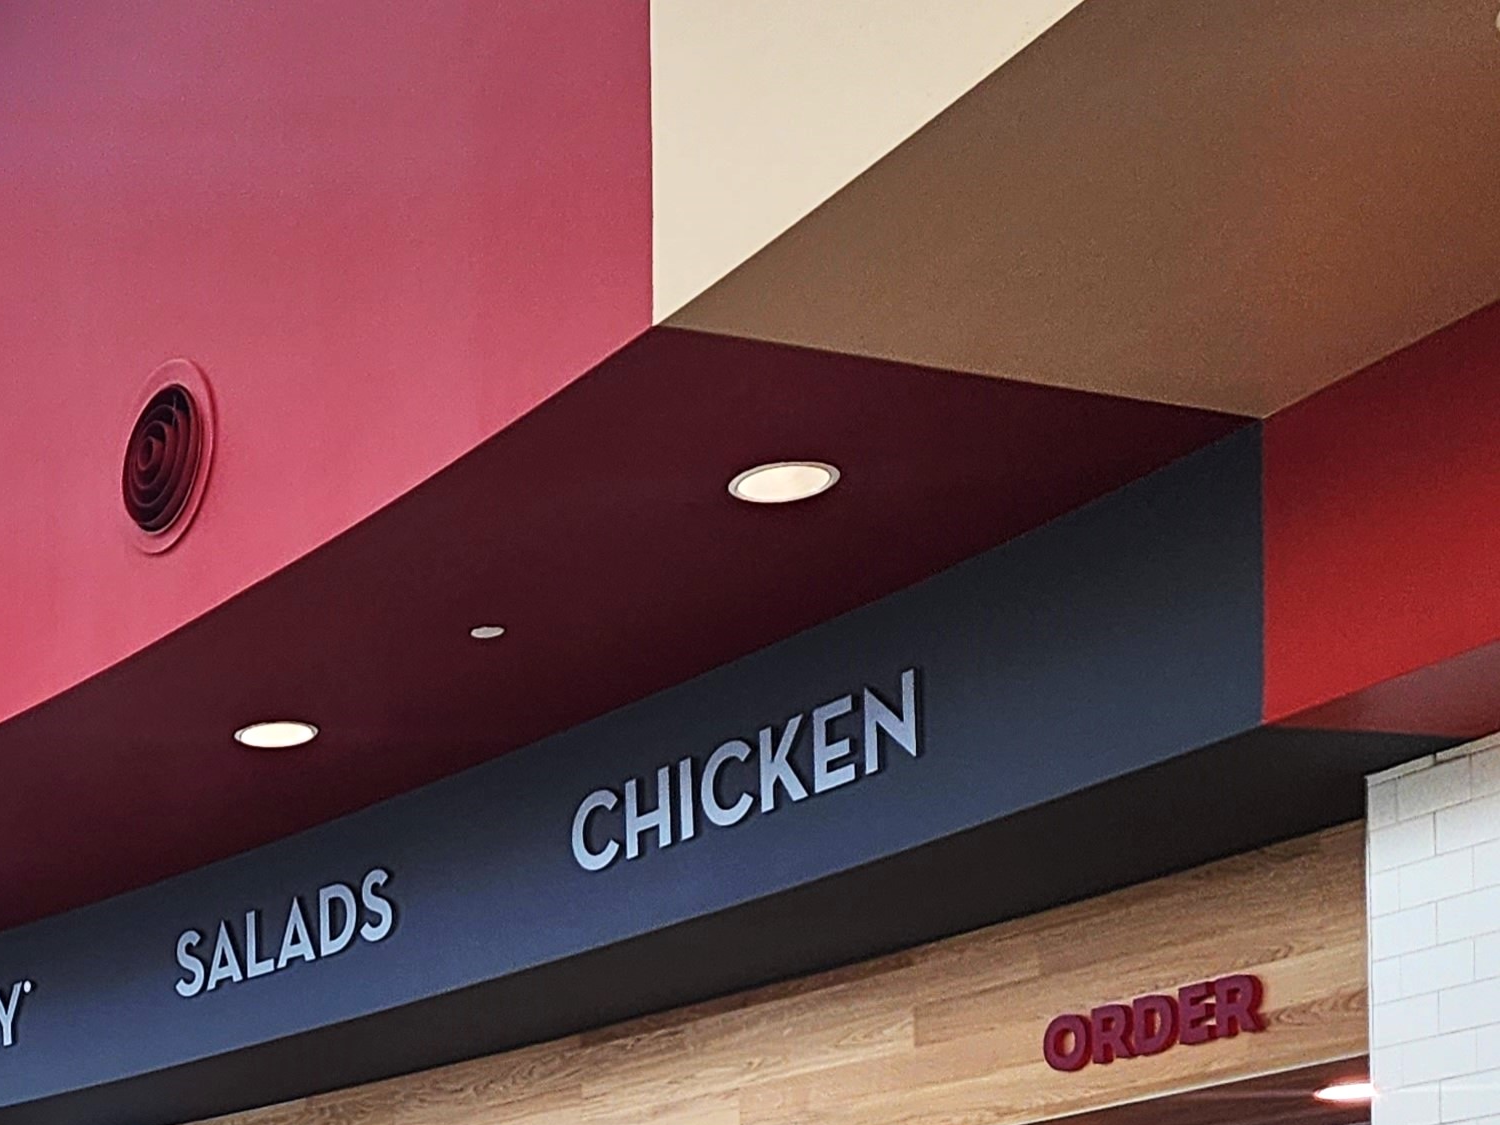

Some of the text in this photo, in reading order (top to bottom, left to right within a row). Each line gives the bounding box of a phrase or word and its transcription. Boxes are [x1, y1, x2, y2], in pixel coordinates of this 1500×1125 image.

[569, 668, 921, 873] CHICKEN
[175, 867, 396, 1000] SALADS
[1043, 973, 1270, 1072] ORDER
